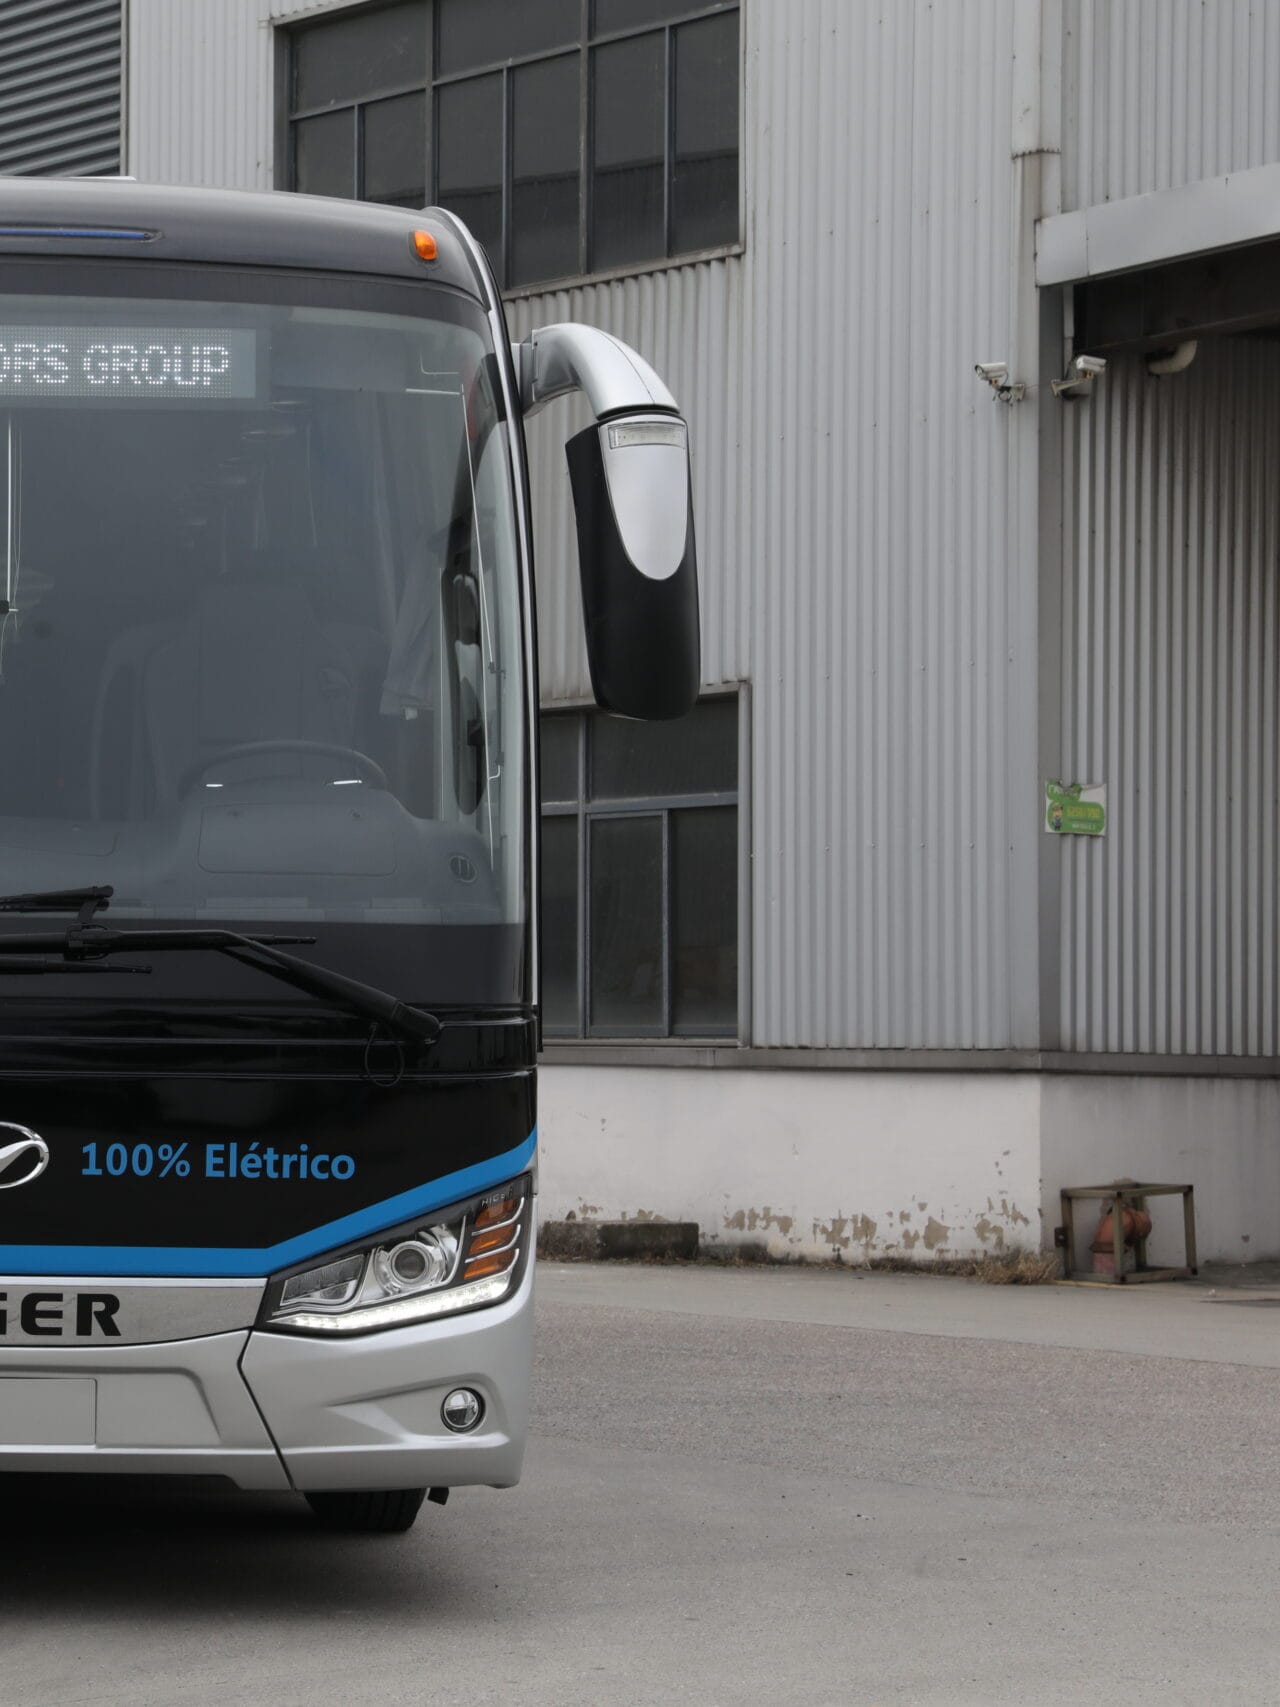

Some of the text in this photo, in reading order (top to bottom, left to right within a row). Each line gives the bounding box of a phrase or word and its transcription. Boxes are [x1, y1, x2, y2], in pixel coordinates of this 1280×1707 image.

[83, 345, 229, 386] GROUP
[80, 1141, 356, 1180] 100% Elétrico
